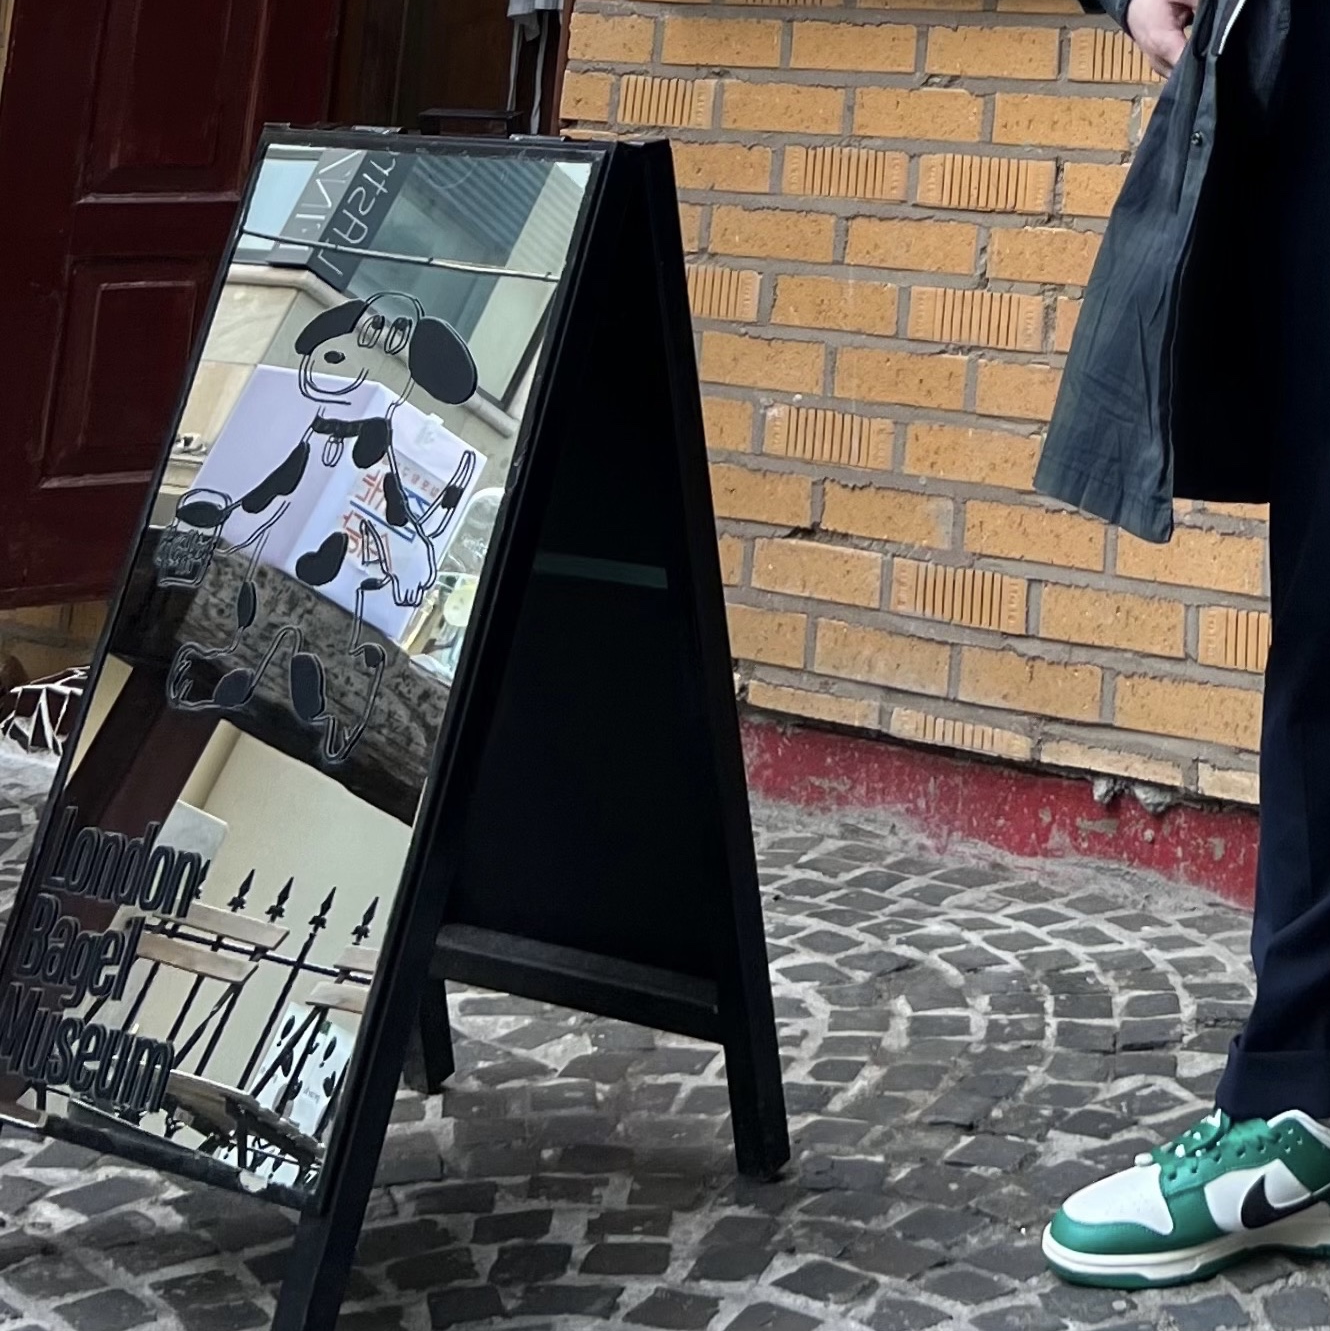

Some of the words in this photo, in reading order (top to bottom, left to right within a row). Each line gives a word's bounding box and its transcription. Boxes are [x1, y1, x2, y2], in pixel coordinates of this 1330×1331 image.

[41, 806, 203, 918] London
[12, 892, 146, 1012] Bagel
[0, 981, 176, 1113] Museum
